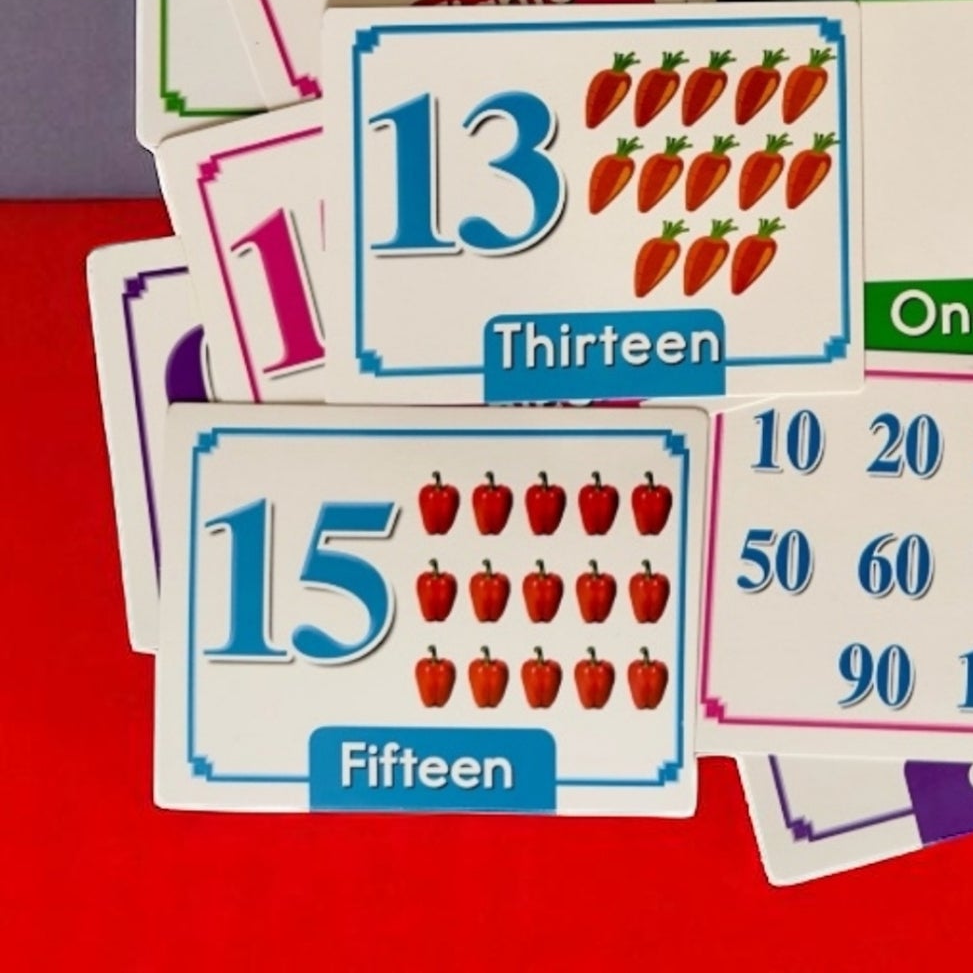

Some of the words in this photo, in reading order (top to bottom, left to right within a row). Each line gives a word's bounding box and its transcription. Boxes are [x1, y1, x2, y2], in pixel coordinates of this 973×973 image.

[368, 90, 567, 259] 13
[230, 199, 325, 380] 1
[493, 322, 722, 370] Thirteen
[751, 409, 824, 474] 10
[866, 412, 943, 478] 20
[203, 497, 400, 665] 15
[737, 530, 813, 594] 50
[858, 533, 934, 598] 60
[838, 643, 914, 709] 90
[340, 742, 515, 790] Fifteen
